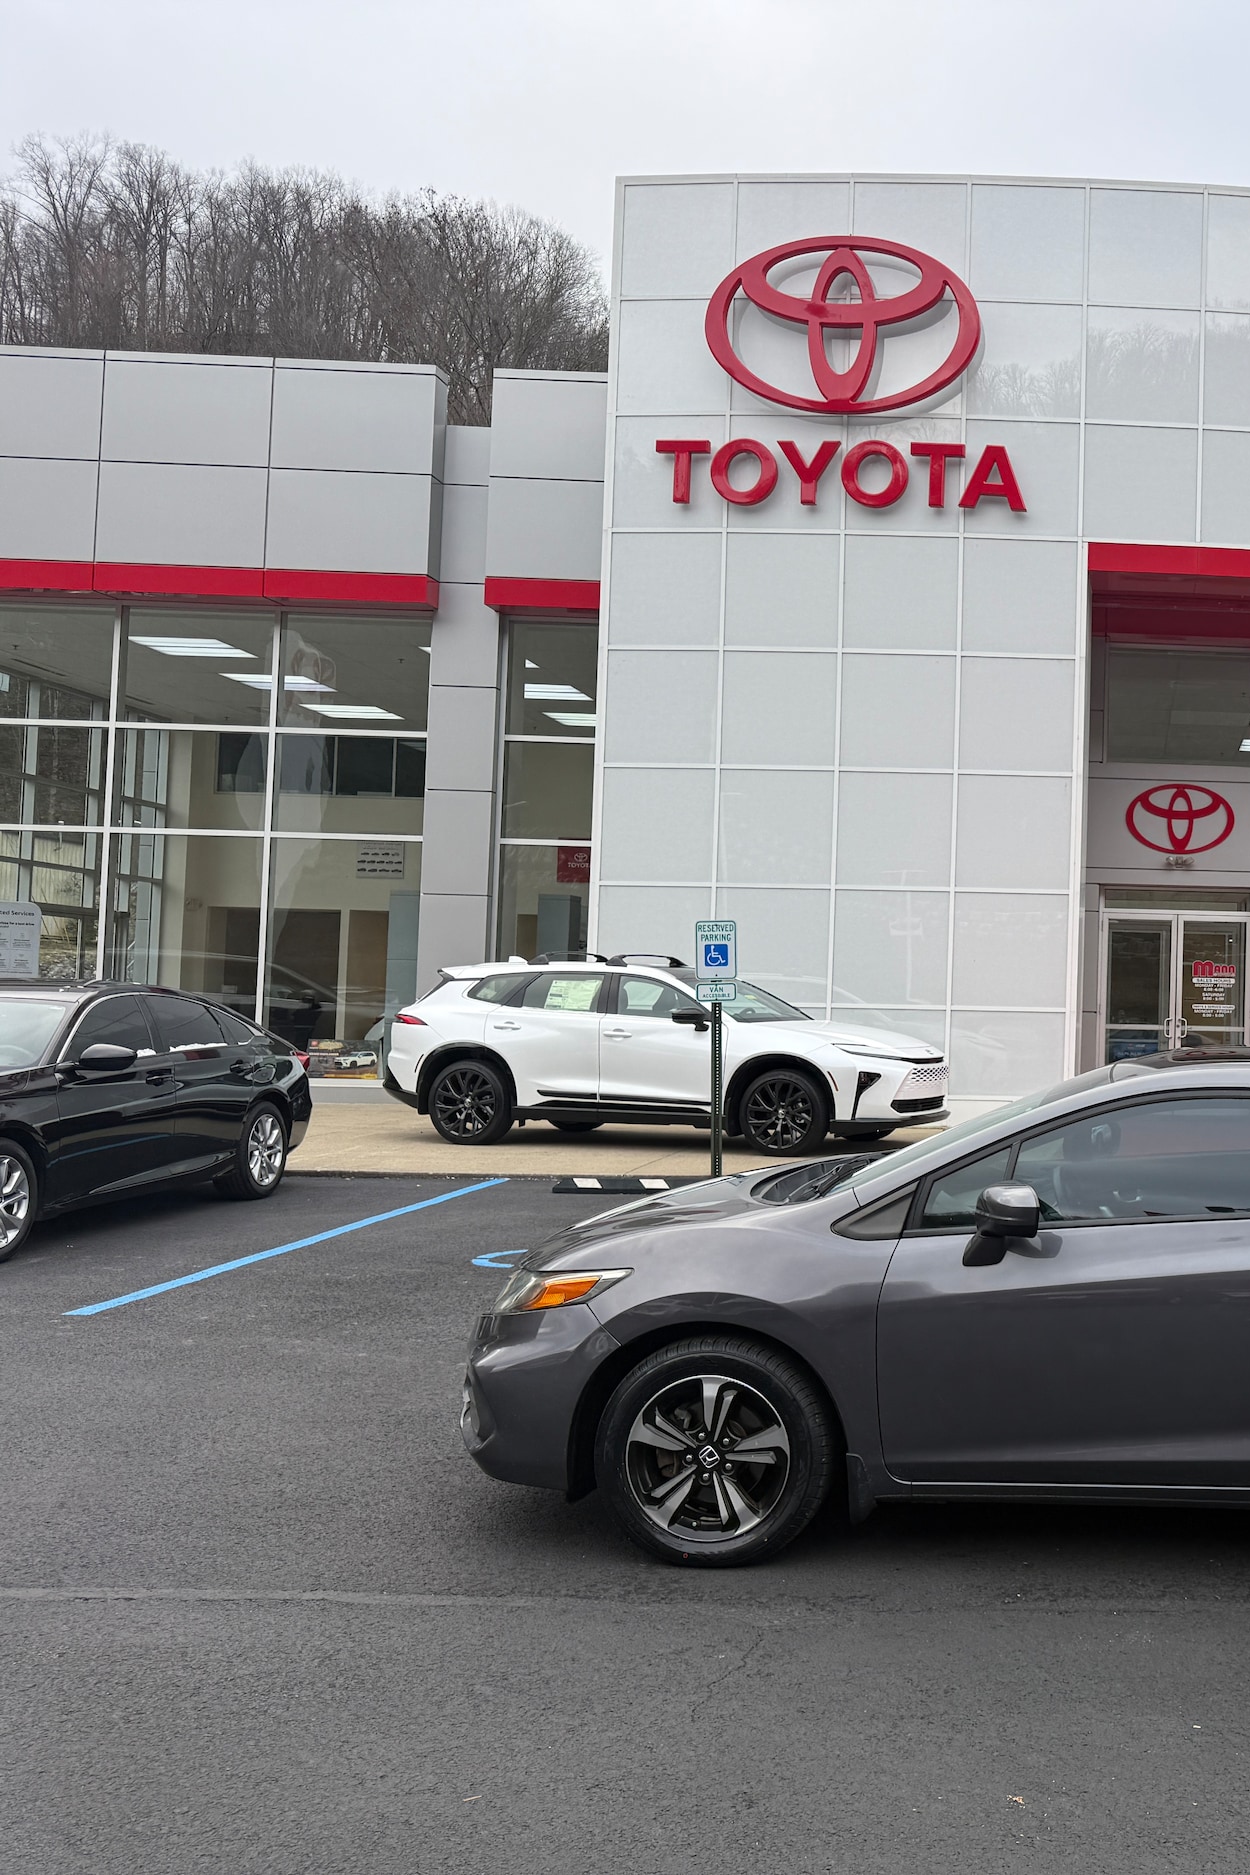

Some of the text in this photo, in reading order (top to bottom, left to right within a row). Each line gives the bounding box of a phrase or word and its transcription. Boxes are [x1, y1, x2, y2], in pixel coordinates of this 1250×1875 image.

[656, 438, 1027, 513] TOYOTA
[697, 924, 735, 933] RESERVED
[700, 933, 732, 942] PARKING
